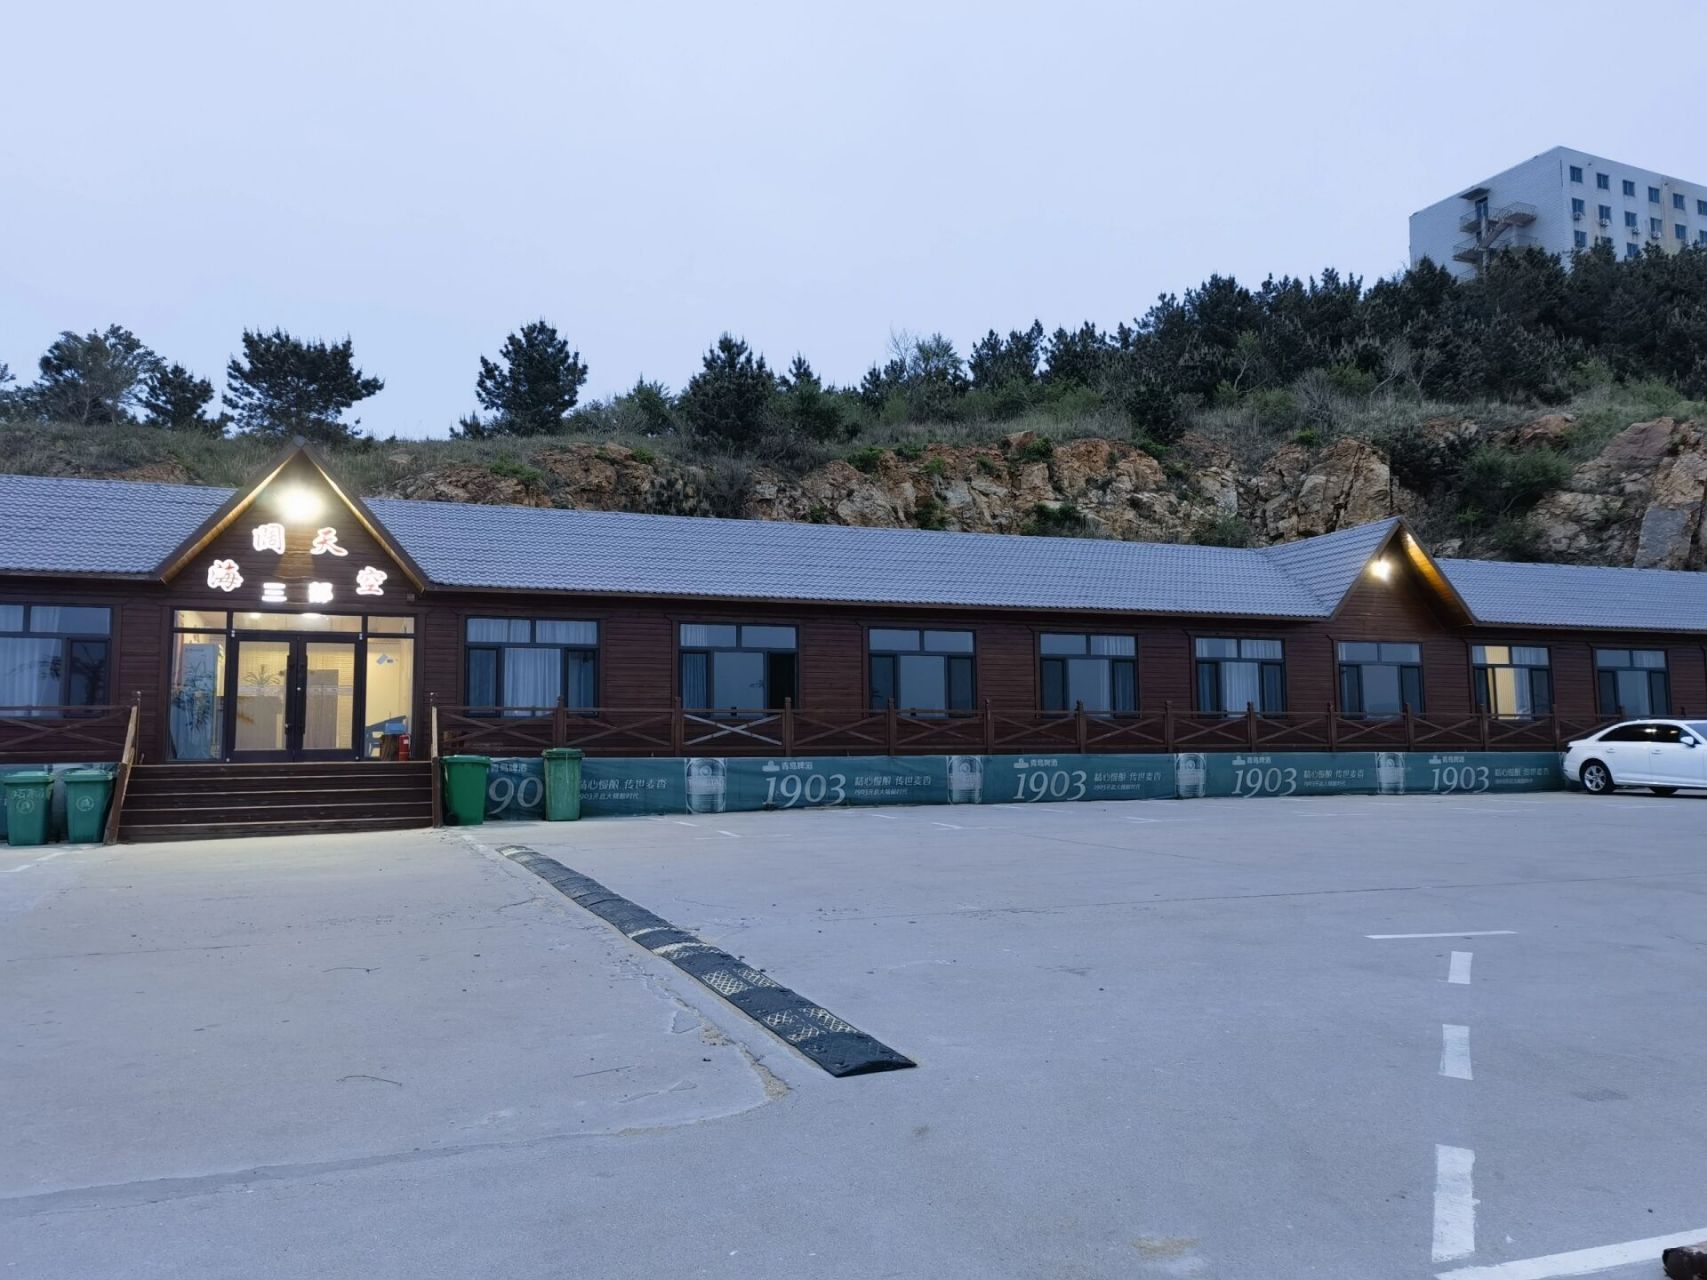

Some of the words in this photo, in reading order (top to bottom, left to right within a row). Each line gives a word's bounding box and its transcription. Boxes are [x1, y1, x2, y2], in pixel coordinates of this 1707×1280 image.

[207, 523, 388, 596] 海阔天空
[488, 777, 544, 815] 90
[763, 773, 846, 808] 1903
[1013, 770, 1087, 802] 1903
[1232, 767, 1297, 798] 1903
[1430, 766, 1490, 794] 1903
